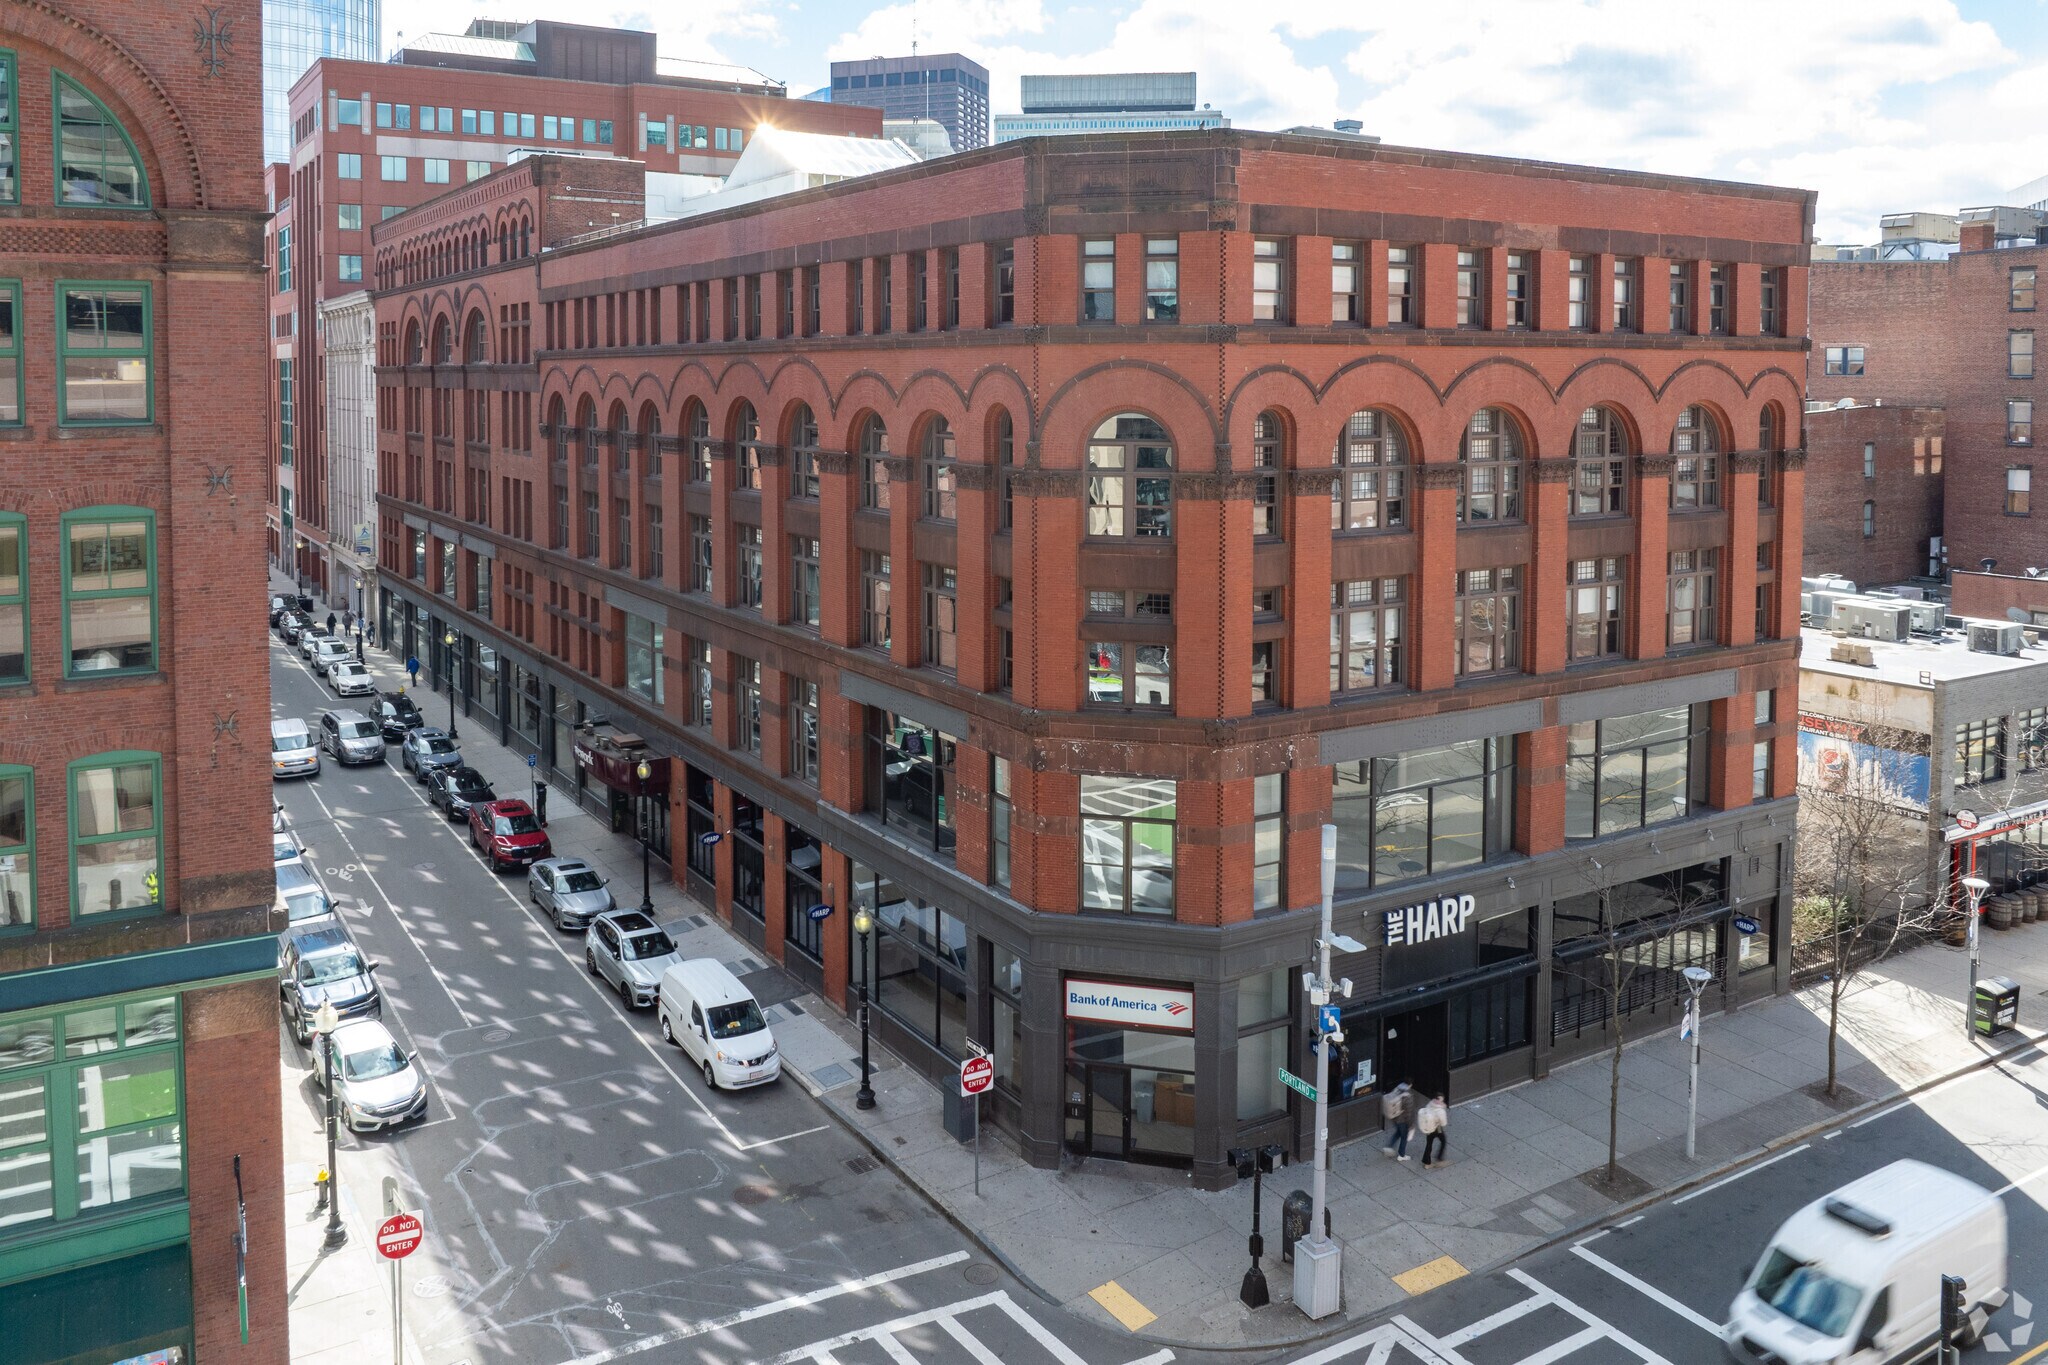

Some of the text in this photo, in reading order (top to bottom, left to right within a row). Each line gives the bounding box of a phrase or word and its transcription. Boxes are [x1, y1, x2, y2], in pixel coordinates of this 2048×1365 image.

[1797, 710, 1825, 720] WELCOME
[815, 907, 830, 918] HARP
[1387, 894, 1475, 946] THE HARP
[1740, 921, 1755, 931] HARP
[1070, 992, 1157, 1012] Bank of America
[966, 1062, 988, 1073] DO NOT
[968, 1078, 986, 1088] ENTER
[1281, 1071, 1310, 1096] PORTLAND
[383, 1220, 416, 1234] DO NOT
[386, 1241, 413, 1253] ENTER
